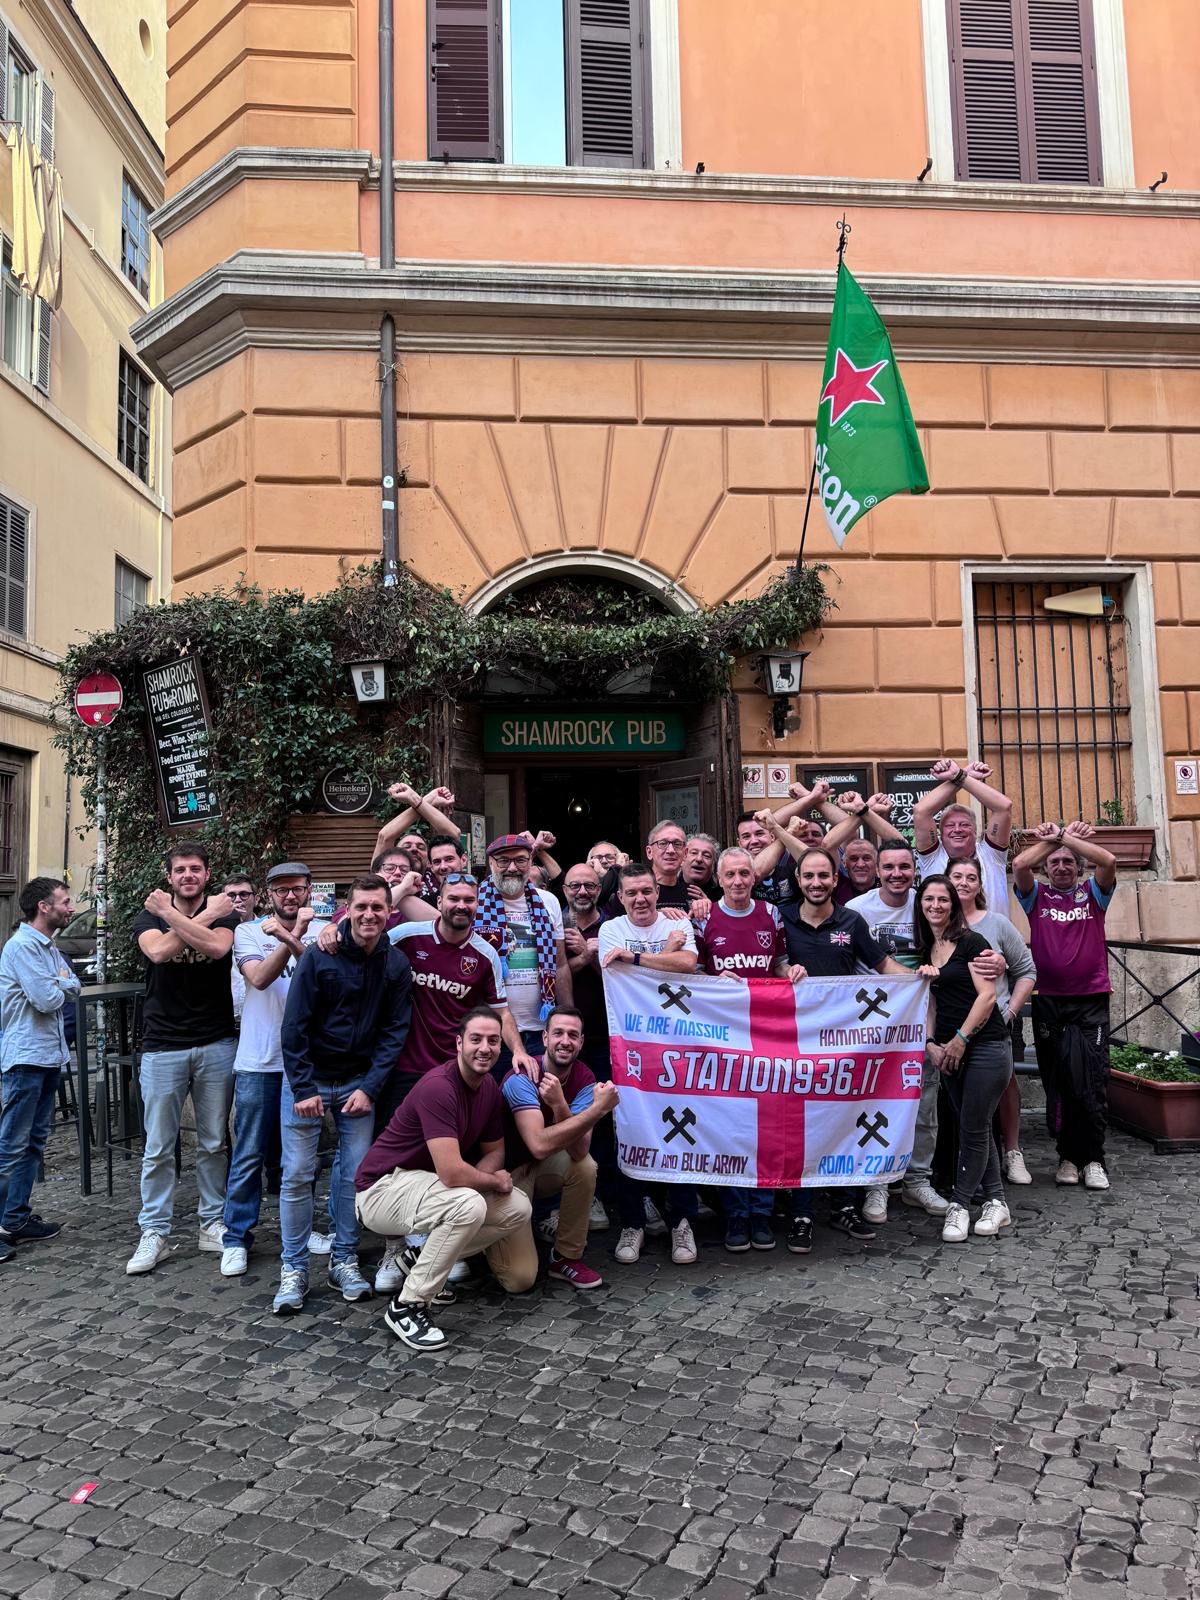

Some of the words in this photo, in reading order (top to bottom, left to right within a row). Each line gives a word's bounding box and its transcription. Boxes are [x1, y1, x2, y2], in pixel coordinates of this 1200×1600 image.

[841, 421, 857, 437] 1873
[147, 661, 195, 693] SHAMROCK
[151, 691, 169, 714] PUB
[171, 682, 199, 707] ROMA
[501, 720, 614, 746] SHAMROCK
[627, 720, 667, 744] PUB
[160, 754, 174, 765] Food
[174, 750, 191, 762] served
[169, 774, 185, 784] SPORT
[186, 769, 207, 781] EVENTS
[176, 764, 196, 774] MAJOR
[183, 780, 196, 788] LIVE
[889, 792, 914, 807] BEER
[713, 953, 772, 971] betway
[625, 1013, 643, 1032] WE
[646, 1016, 671, 1035] ARE
[674, 1019, 729, 1041] MASSIVE
[820, 1027, 882, 1047] HAMMERS
[657, 1049, 886, 1096] STATION936.IT
[661, 1154, 678, 1169] AND
[681, 1152, 710, 1172] BLUE
[713, 1155, 748, 1174] ARMY
[818, 1155, 854, 1174] ROMA
